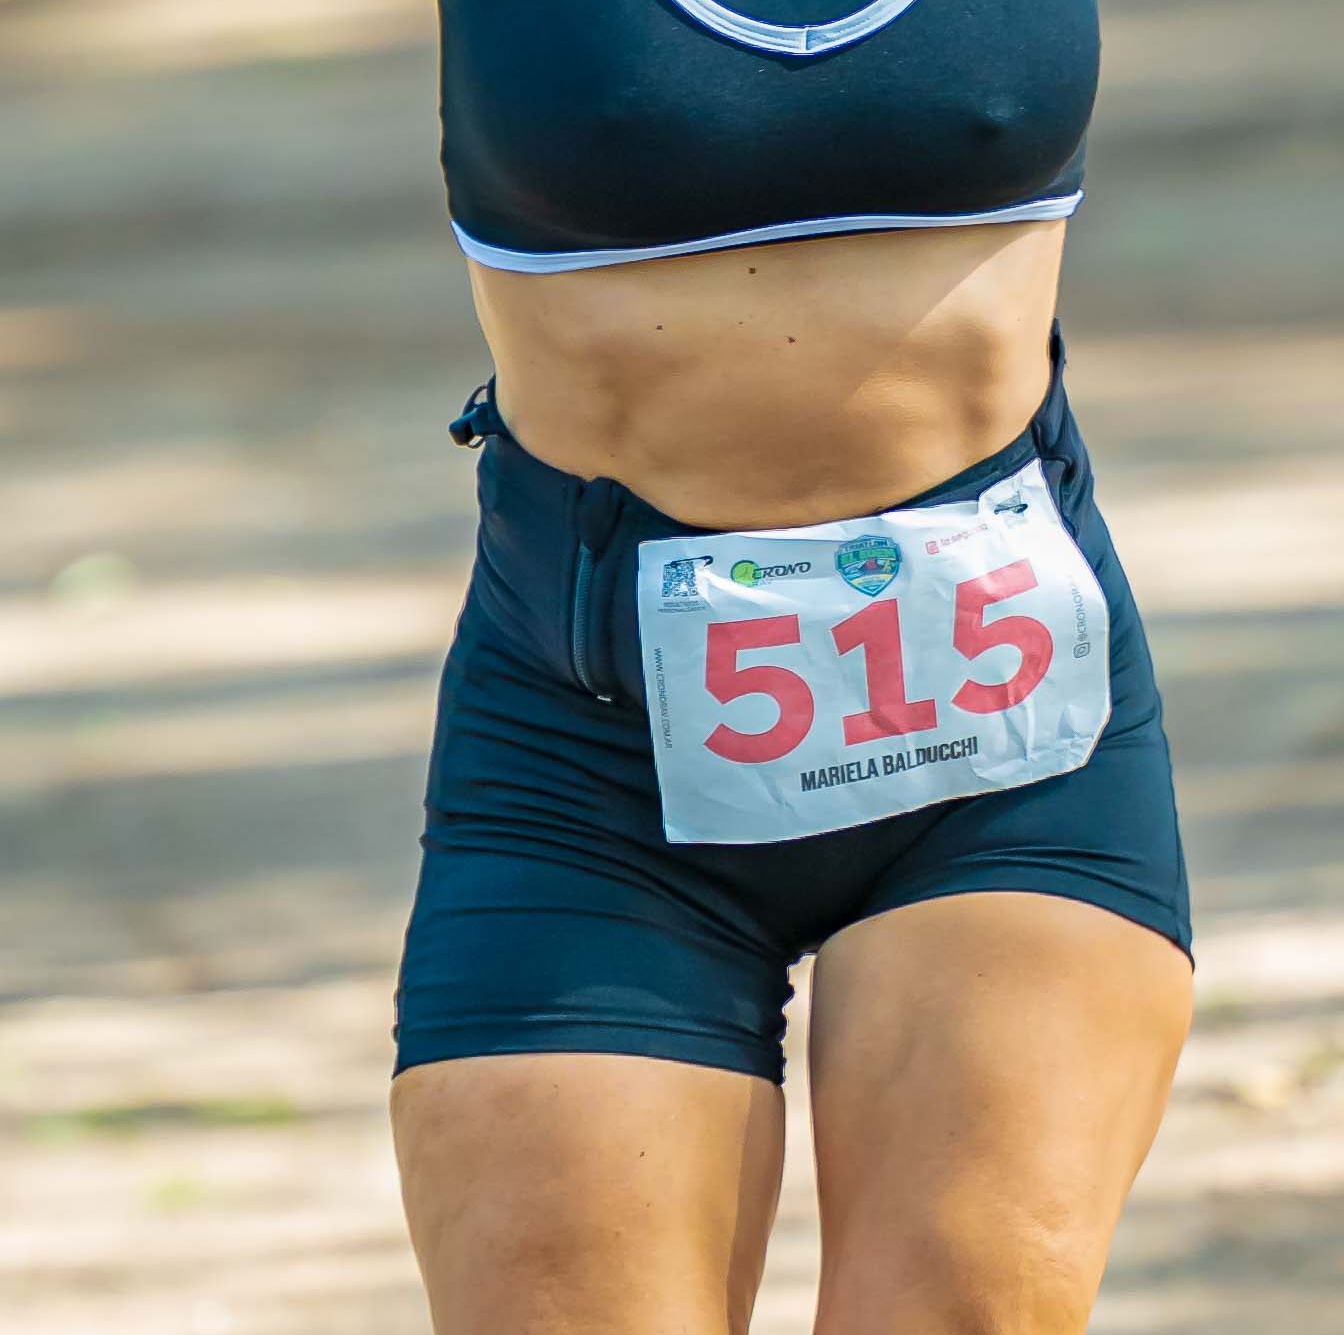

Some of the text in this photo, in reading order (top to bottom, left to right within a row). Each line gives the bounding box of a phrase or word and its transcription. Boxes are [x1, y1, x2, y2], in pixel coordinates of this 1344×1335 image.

[752, 562, 811, 580] CRONO
[704, 558, 1054, 764] 515
[800, 736, 978, 792] MARIELA BALDUCCHI
